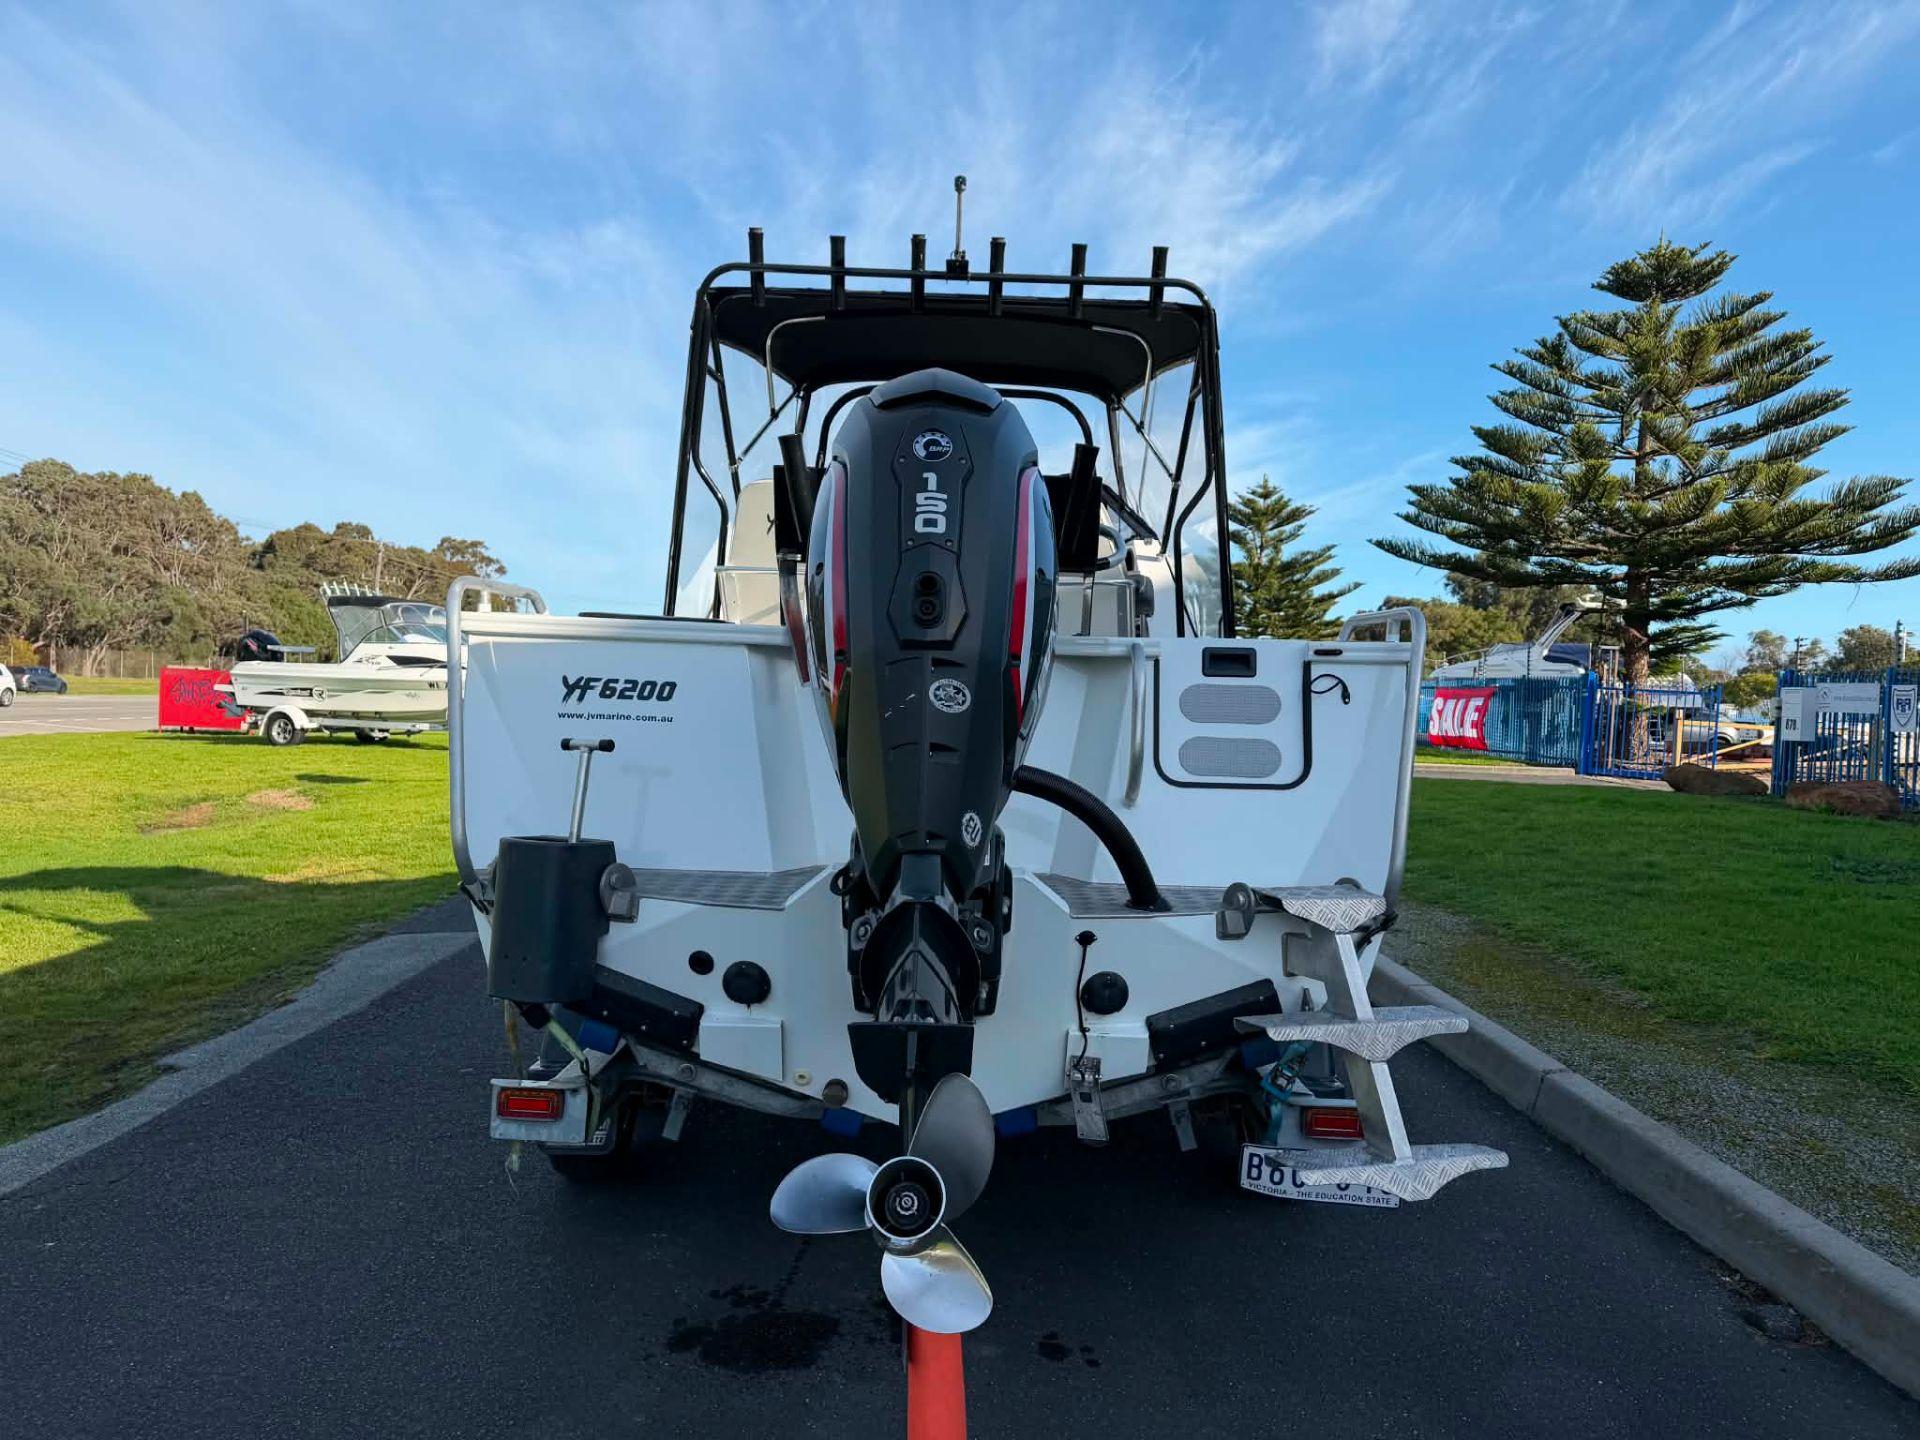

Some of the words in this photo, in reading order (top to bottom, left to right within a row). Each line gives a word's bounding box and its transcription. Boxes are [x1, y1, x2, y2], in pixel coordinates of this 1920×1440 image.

[914, 472, 947, 533] 150
[557, 711, 674, 723] www.jvmarine.com.au
[1429, 697, 1484, 737] SALE
[1248, 1182, 1288, 1195] VICTORIA
[1296, 1191, 1313, 1199] THE
[1315, 1192, 1363, 1203] EDUCATION
[1365, 1197, 1391, 1206] STATE
